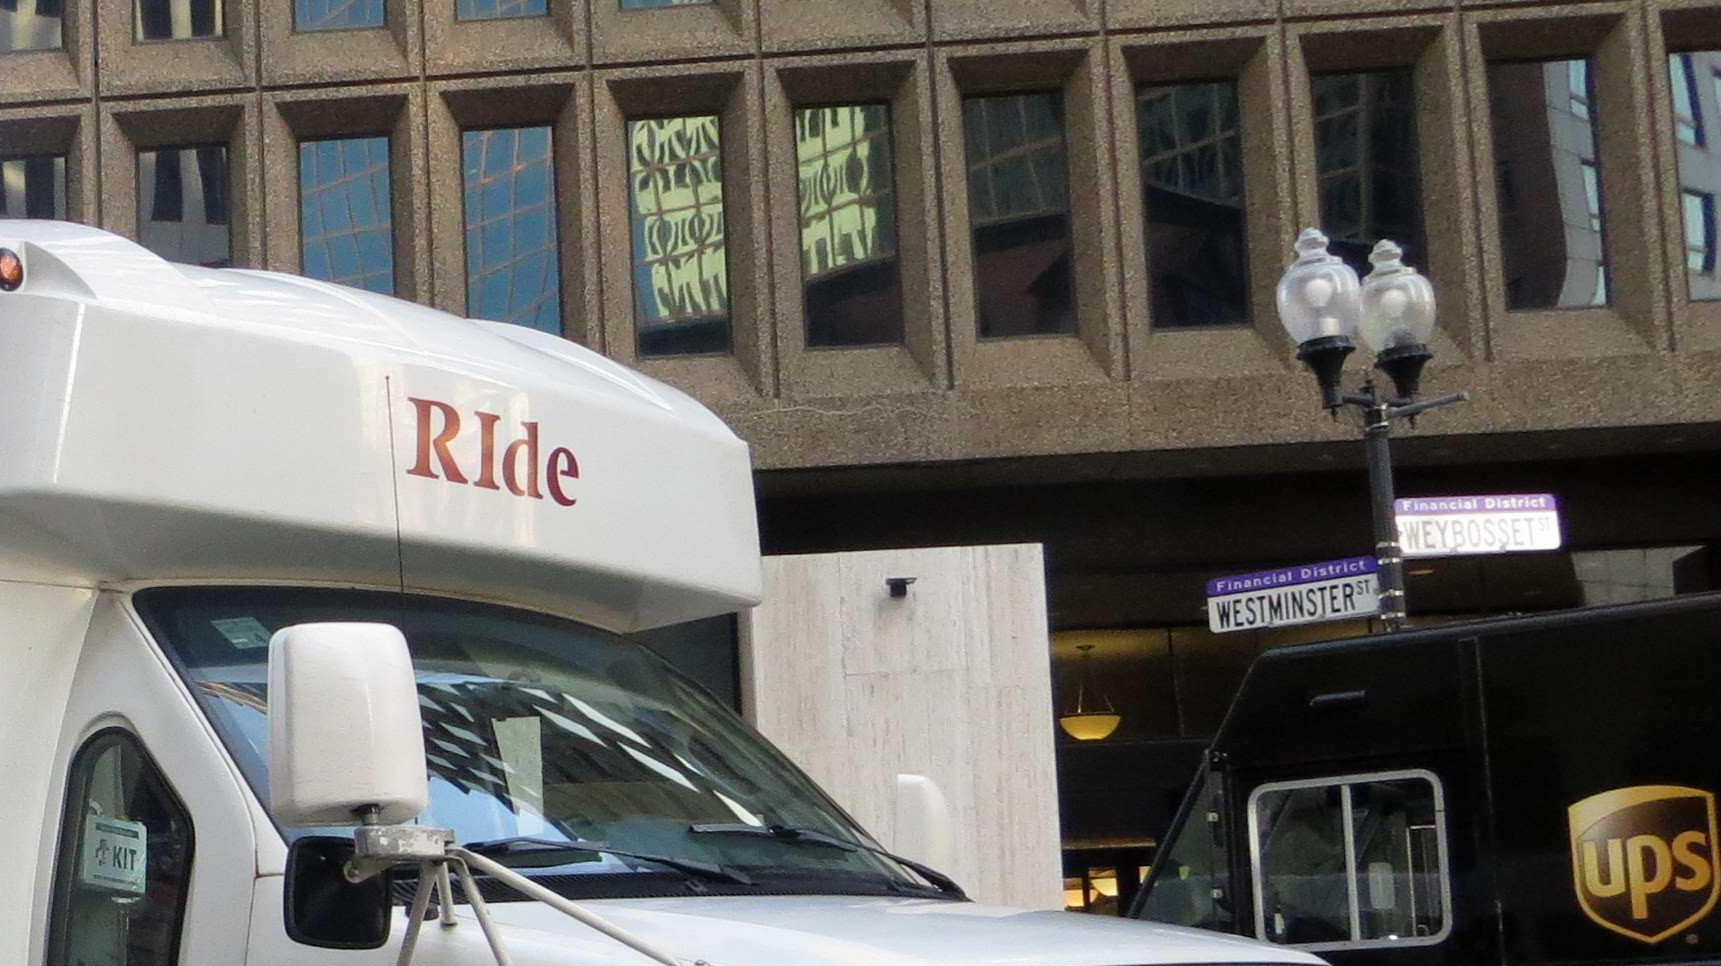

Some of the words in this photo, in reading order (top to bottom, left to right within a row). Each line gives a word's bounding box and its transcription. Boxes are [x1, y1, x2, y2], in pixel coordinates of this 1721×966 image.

[406, 397, 579, 507] RIde
[1402, 499, 1478, 512] Financial
[1485, 496, 1546, 509] District
[1403, 518, 1535, 550] WEYBOSSET
[1537, 516, 1551, 532] ST
[1216, 573, 1292, 592] Financial
[1301, 560, 1366, 580] District
[1216, 583, 1356, 629] WESTMINSTER
[1356, 579, 1371, 596] ST
[112, 845, 137, 871] KIT
